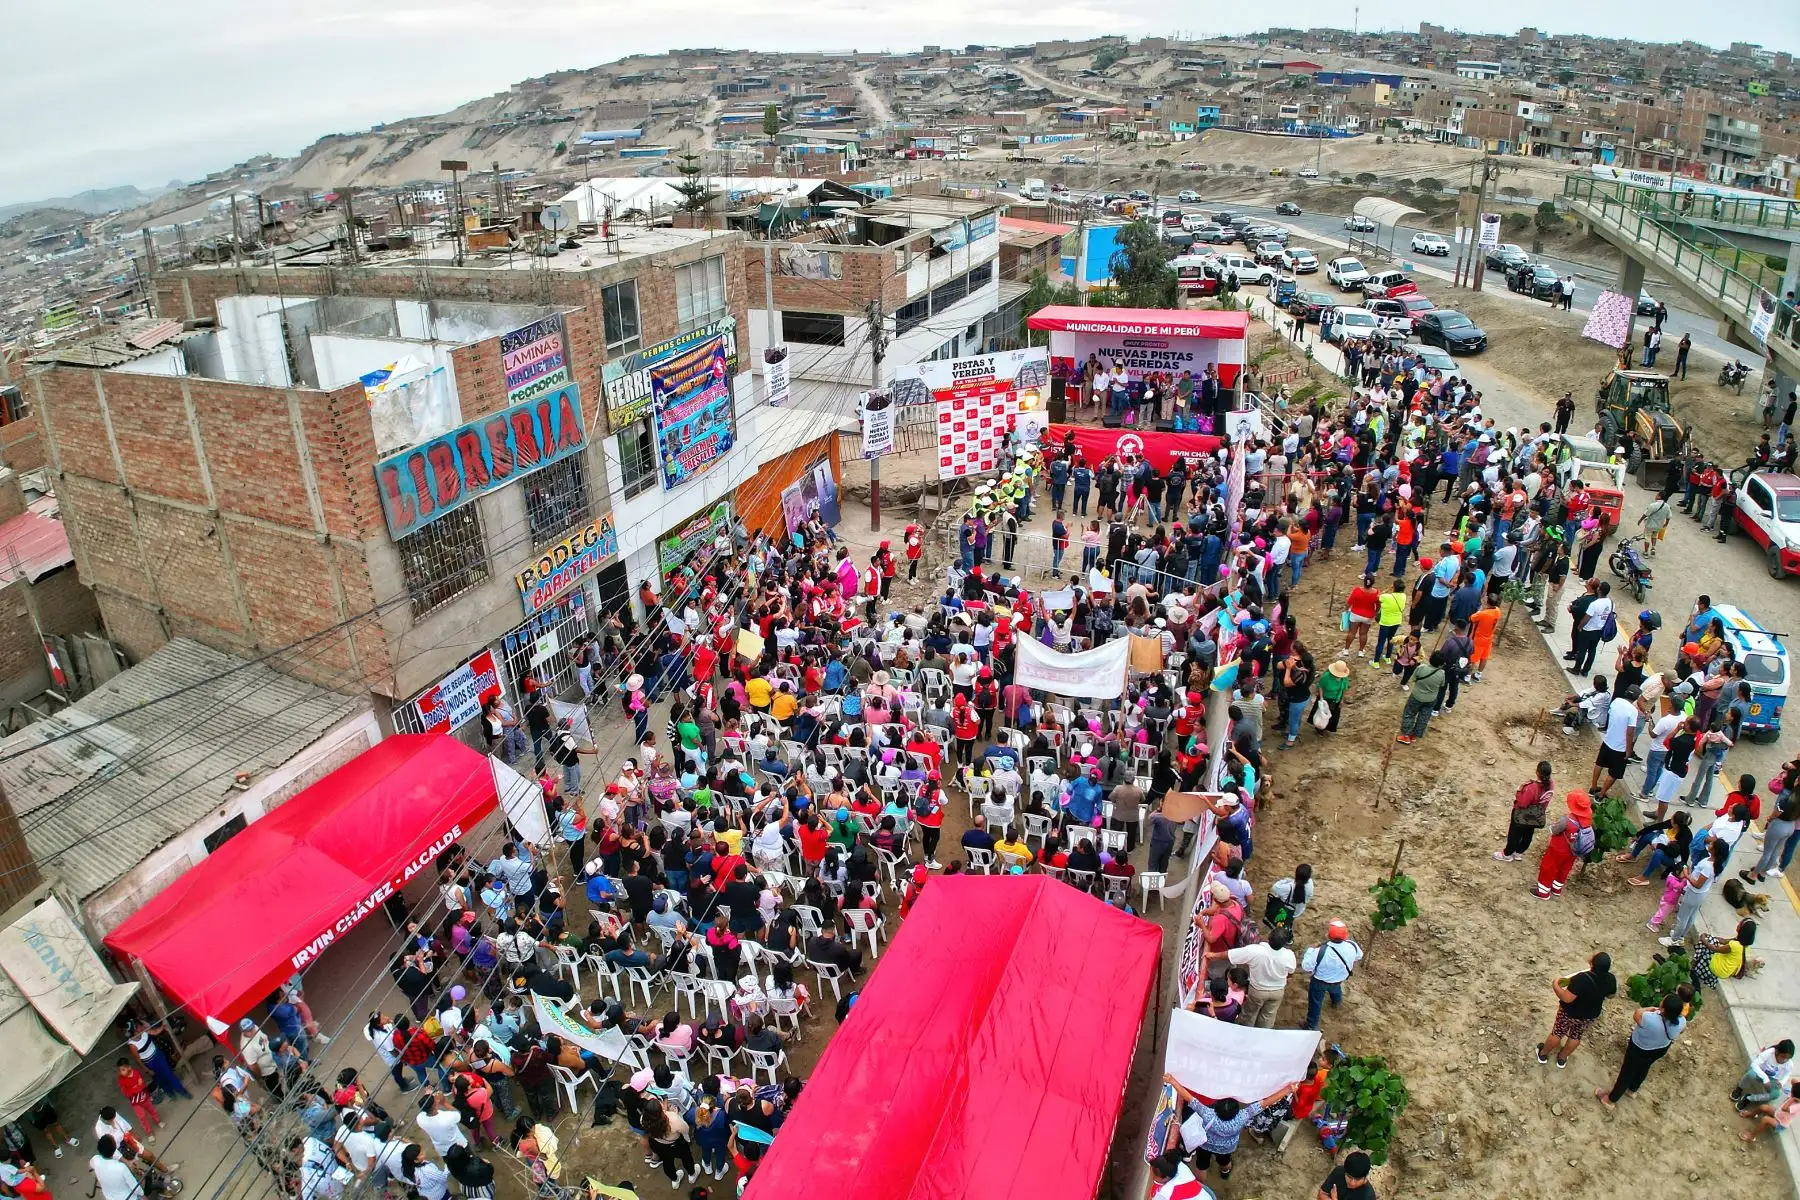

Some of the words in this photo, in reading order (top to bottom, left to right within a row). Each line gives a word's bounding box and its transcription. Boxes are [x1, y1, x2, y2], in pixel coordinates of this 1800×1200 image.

[500, 318, 559, 354] BAZAR
[1066, 322, 1142, 335] MUNICIPALIDAD
[1145, 325, 1158, 335] DE
[1160, 326, 1172, 335] MI
[1174, 325, 1200, 336] PERÚ
[504, 337, 559, 371] LAMINAS
[643, 341, 675, 359] PERNOS
[676, 328, 706, 345] CENTRO
[1098, 347, 1148, 358] NUEVAS
[1150, 350, 1194, 361] PISTAS
[507, 353, 562, 387] MAQUETAS
[952, 366, 996, 379] VEREDAS
[953, 361, 985, 371] PISTAS
[988, 358, 995, 366] Y
[1122, 358, 1180, 370] VEREDAS
[868, 435, 890, 445] VEREDAS
[869, 426, 889, 435] NUEVAS
[381, 391, 585, 530] LIBRERIA
[522, 517, 614, 591] BODEGA
[450, 668, 477, 691] REGIONAL
[423, 704, 447, 731] TODOS
[443, 688, 469, 717] UNIDOS
[450, 715, 460, 728] MI
[458, 701, 480, 720] PERÚ
[291, 929, 335, 969] IRVIN
[335, 881, 394, 934] CHÁVEZ
[403, 824, 462, 881] ALCALDE
